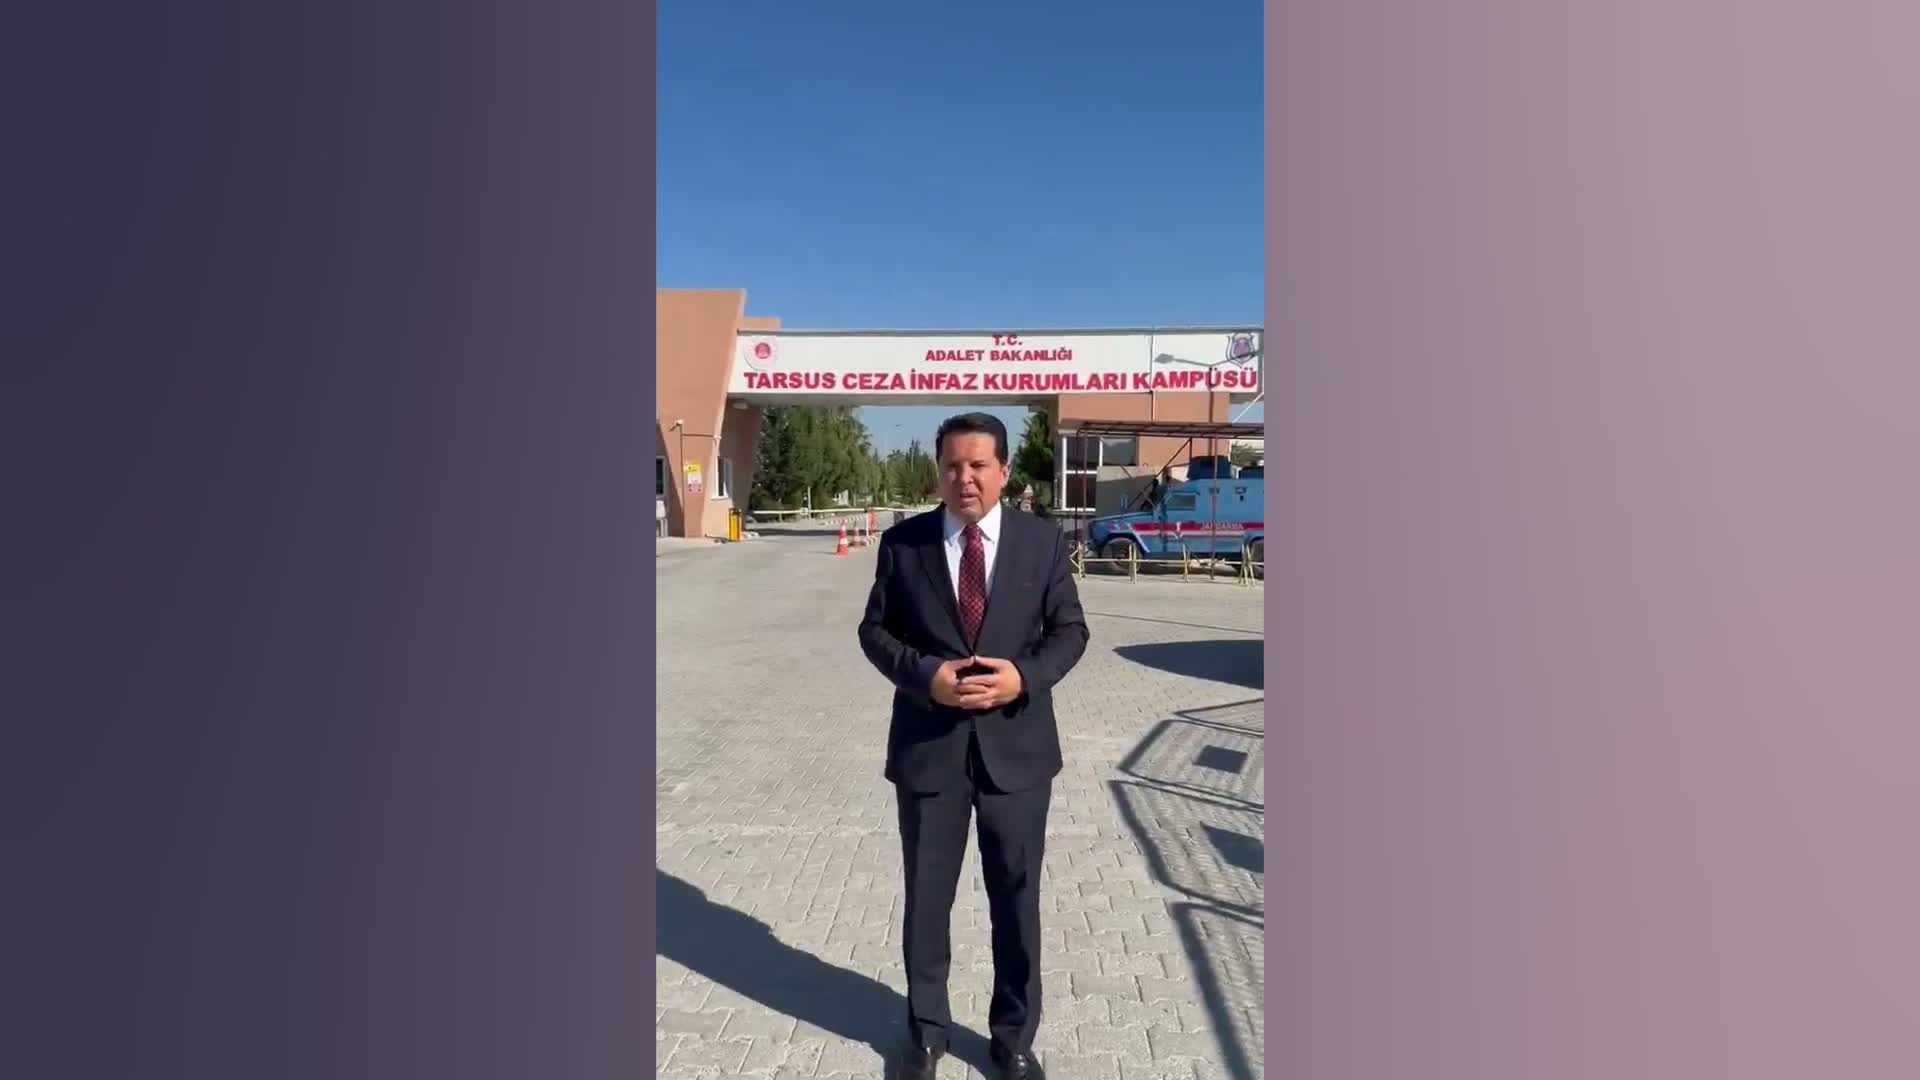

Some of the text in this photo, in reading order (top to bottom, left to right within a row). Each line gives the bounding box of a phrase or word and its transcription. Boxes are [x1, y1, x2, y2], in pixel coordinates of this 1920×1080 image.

[992, 334, 1023, 346] T.C.
[925, 347, 1072, 361] ADALET BAKANLIĞI
[743, 367, 1257, 391] TARSUS CEZA İNFAZ KURUMLARI KAMPÜSÜ
